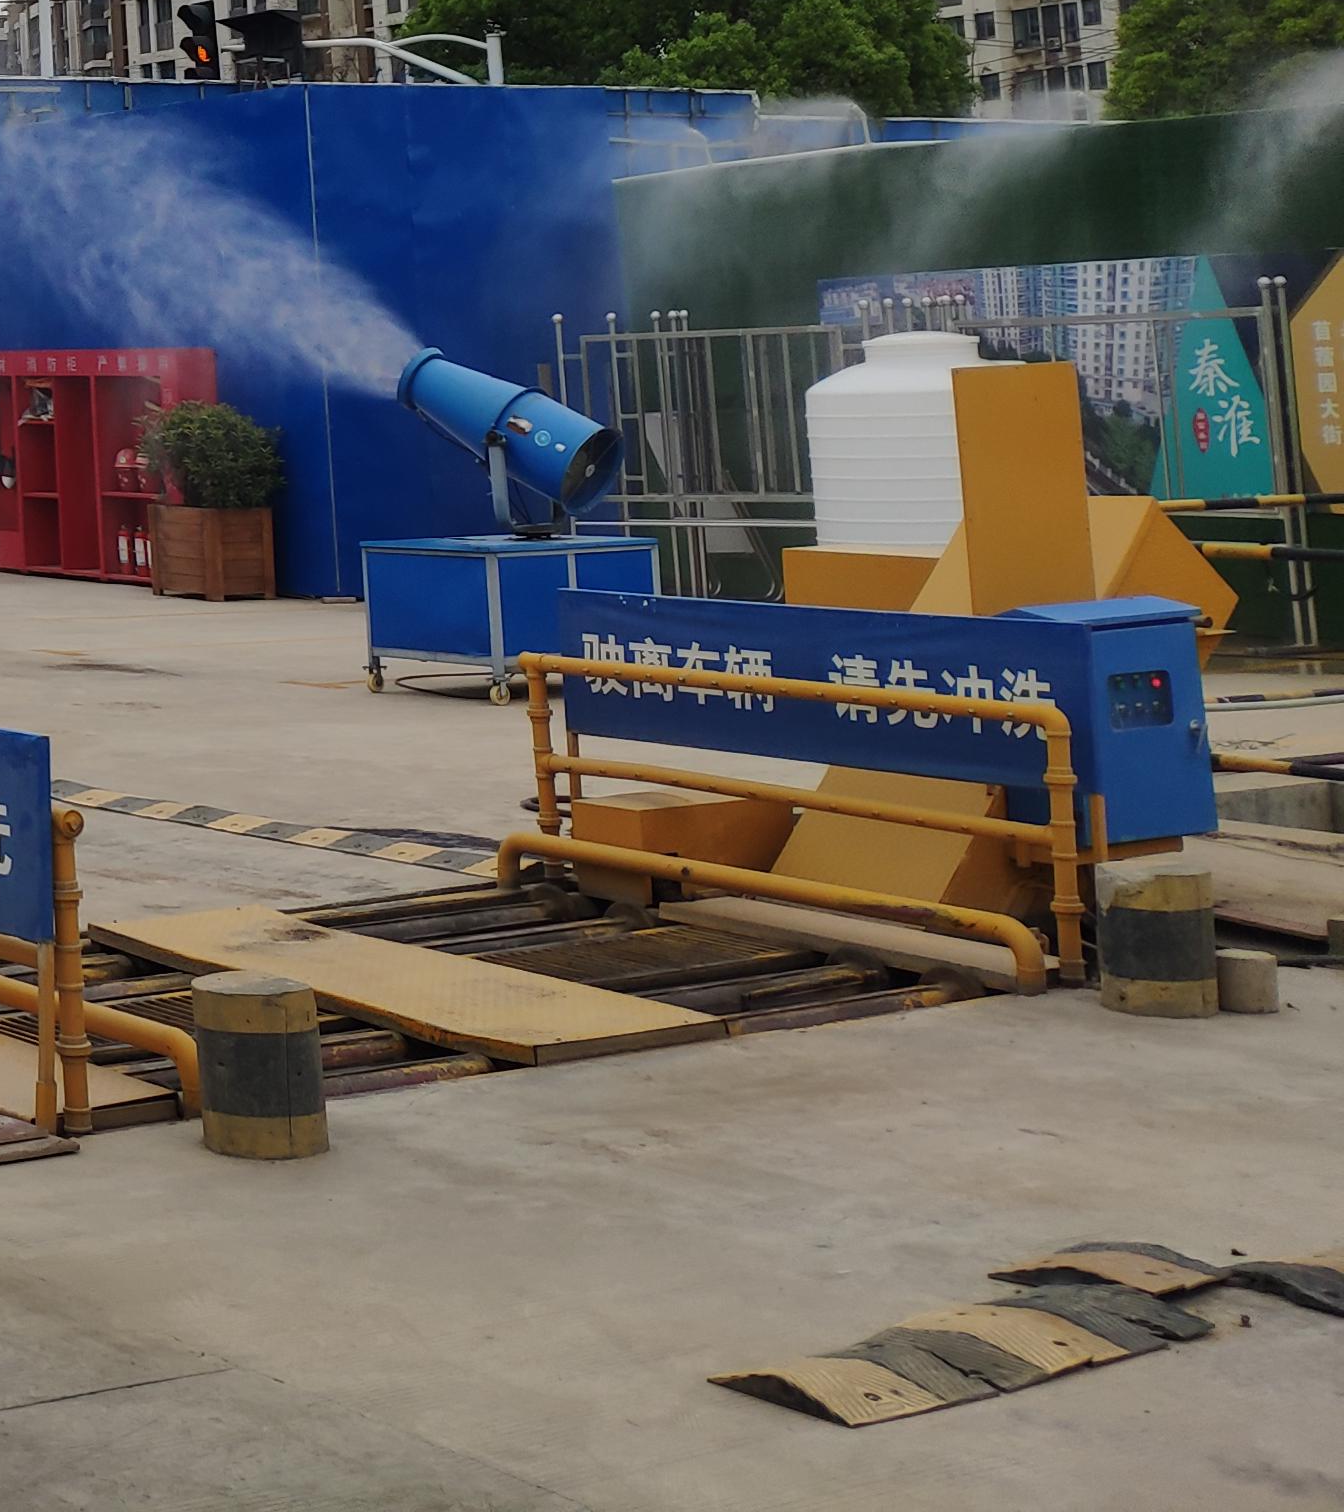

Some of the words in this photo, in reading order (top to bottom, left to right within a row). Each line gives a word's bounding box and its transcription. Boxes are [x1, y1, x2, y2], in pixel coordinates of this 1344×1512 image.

[1188, 338, 1261, 458] 秦淮
[581, 632, 775, 713] 驶离车辆
[827, 653, 1057, 741] 请先冲洗
